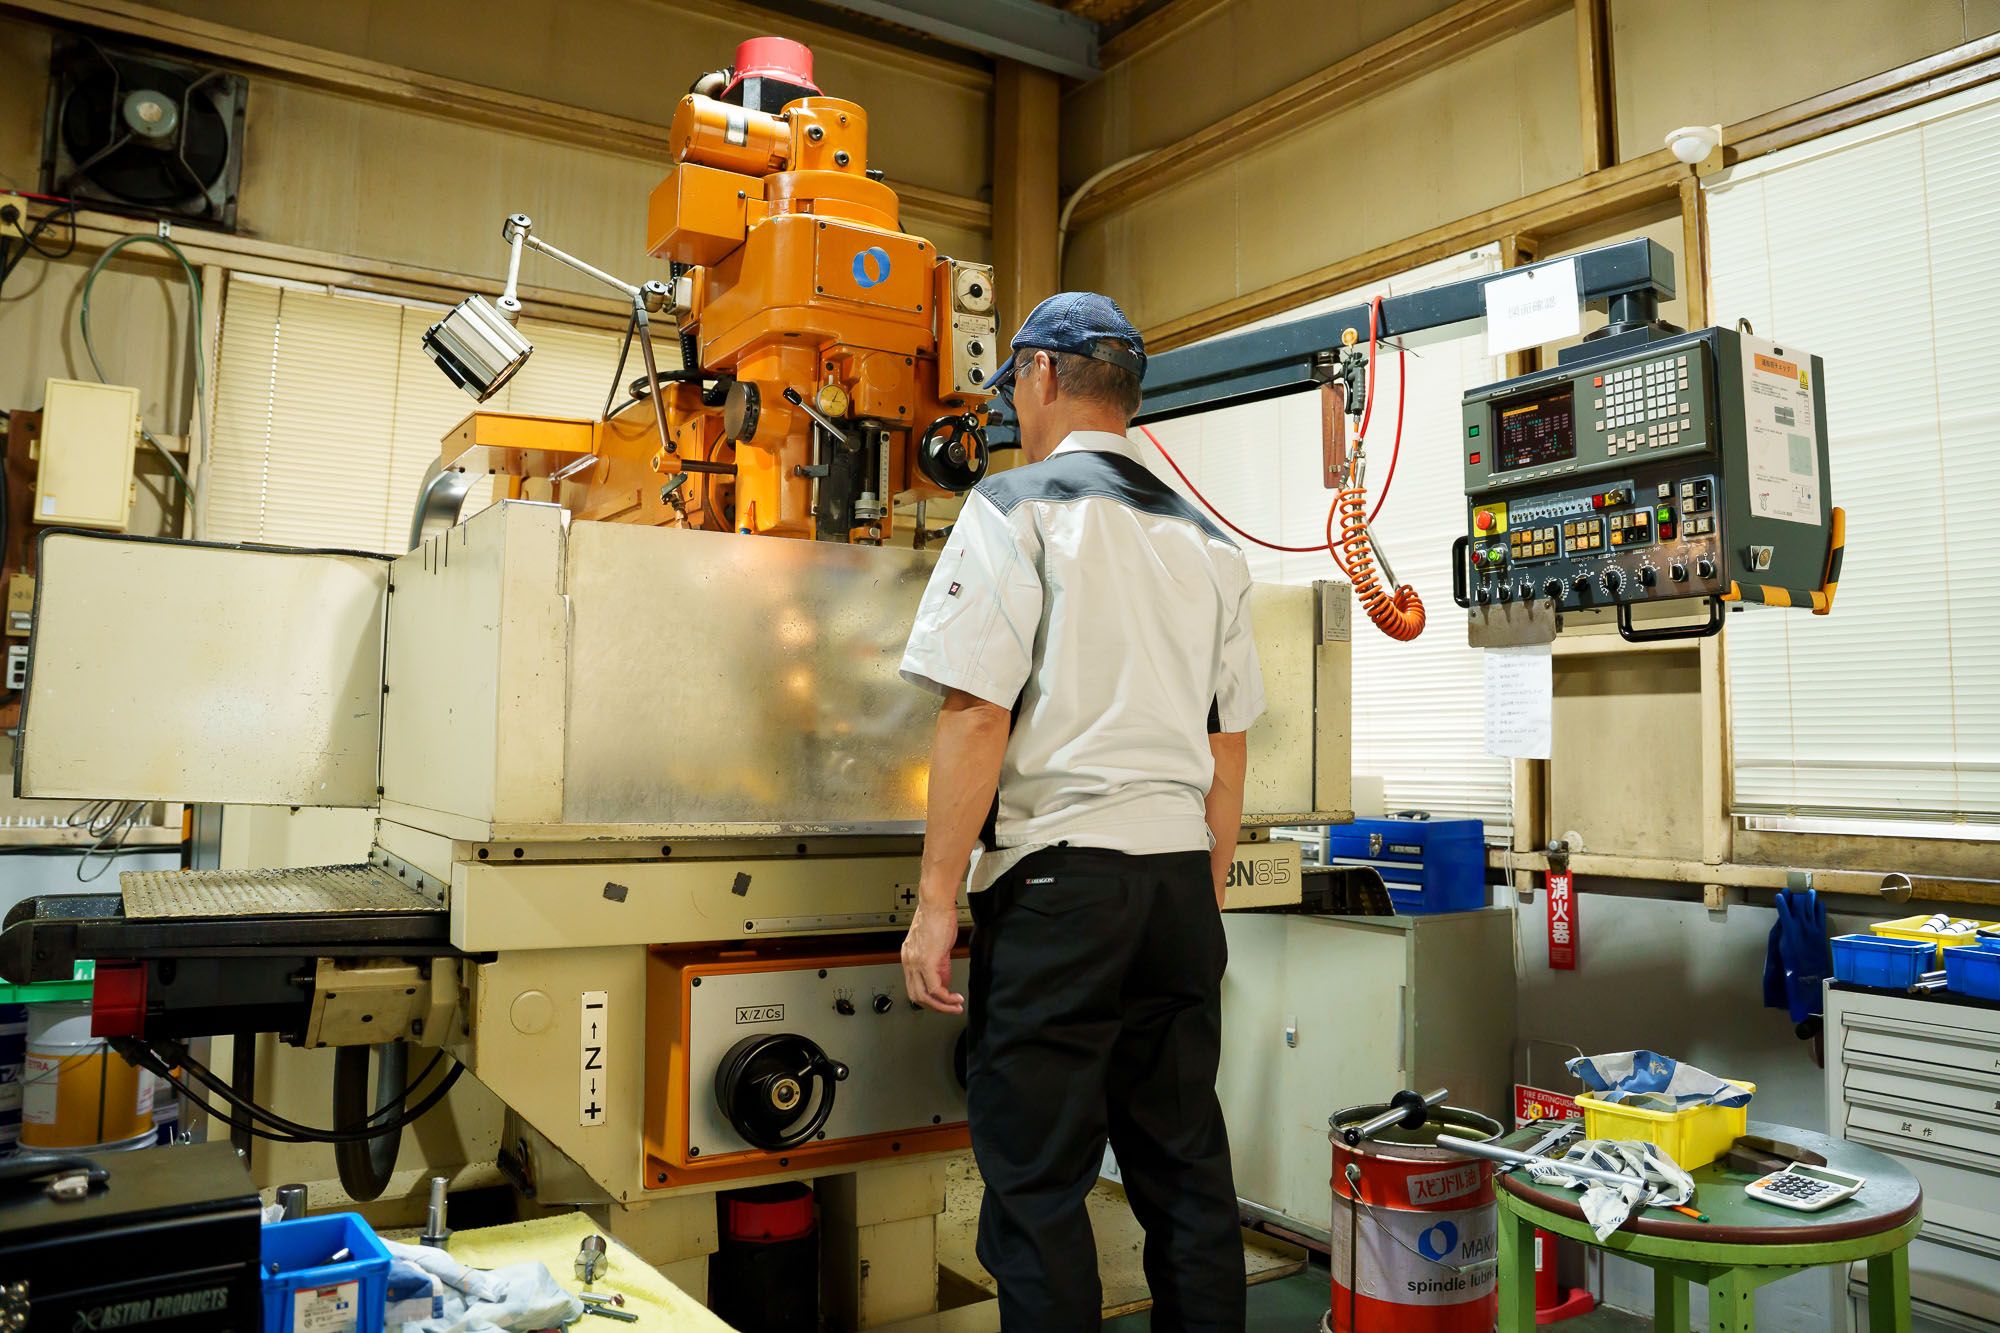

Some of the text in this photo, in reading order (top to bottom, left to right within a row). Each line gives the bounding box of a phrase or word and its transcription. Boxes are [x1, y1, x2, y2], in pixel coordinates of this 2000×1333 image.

[1550, 876, 1570, 944] 消火器
[739, 1008, 781, 1021] X/Z/Cs
[1523, 1089, 1537, 1099] FIRE
[1407, 1277, 1466, 1295] spindle
[101, 1287, 229, 1330] ASTRO PRODUCTS
